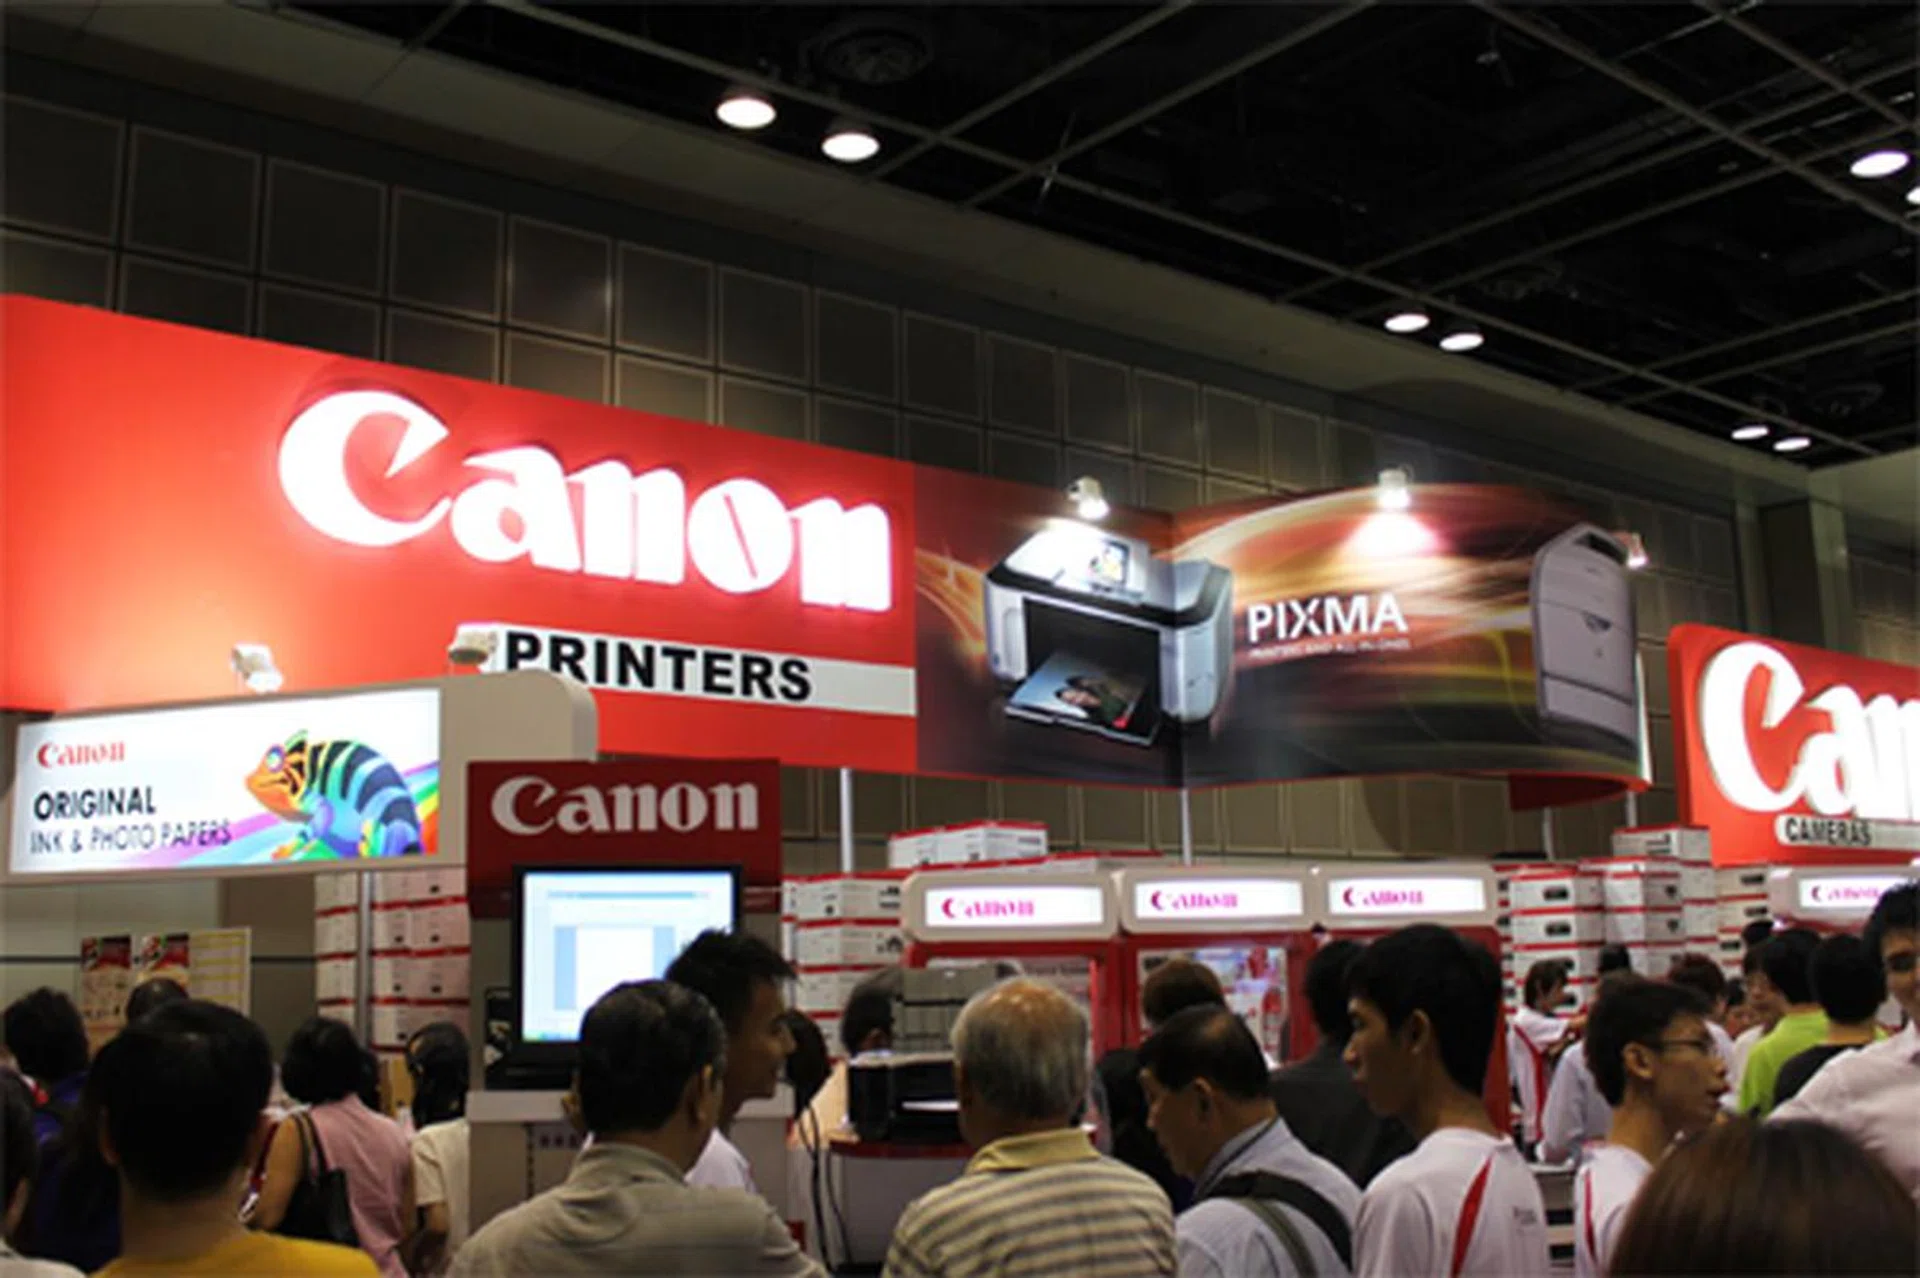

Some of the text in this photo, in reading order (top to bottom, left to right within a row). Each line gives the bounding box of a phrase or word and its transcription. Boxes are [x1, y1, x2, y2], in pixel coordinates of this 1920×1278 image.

[278, 389, 892, 613] Canon
[1248, 592, 1409, 643] PIXMA
[506, 630, 811, 702] PRINTERS
[36, 741, 125, 769] Canon
[34, 786, 156, 821] ORIGINAL
[491, 775, 759, 835] Canon
[30, 829, 63, 854] INK
[92, 823, 155, 850] PHOTO
[161, 817, 232, 847] PAPERS
[1784, 817, 1872, 847] CAMERAS
